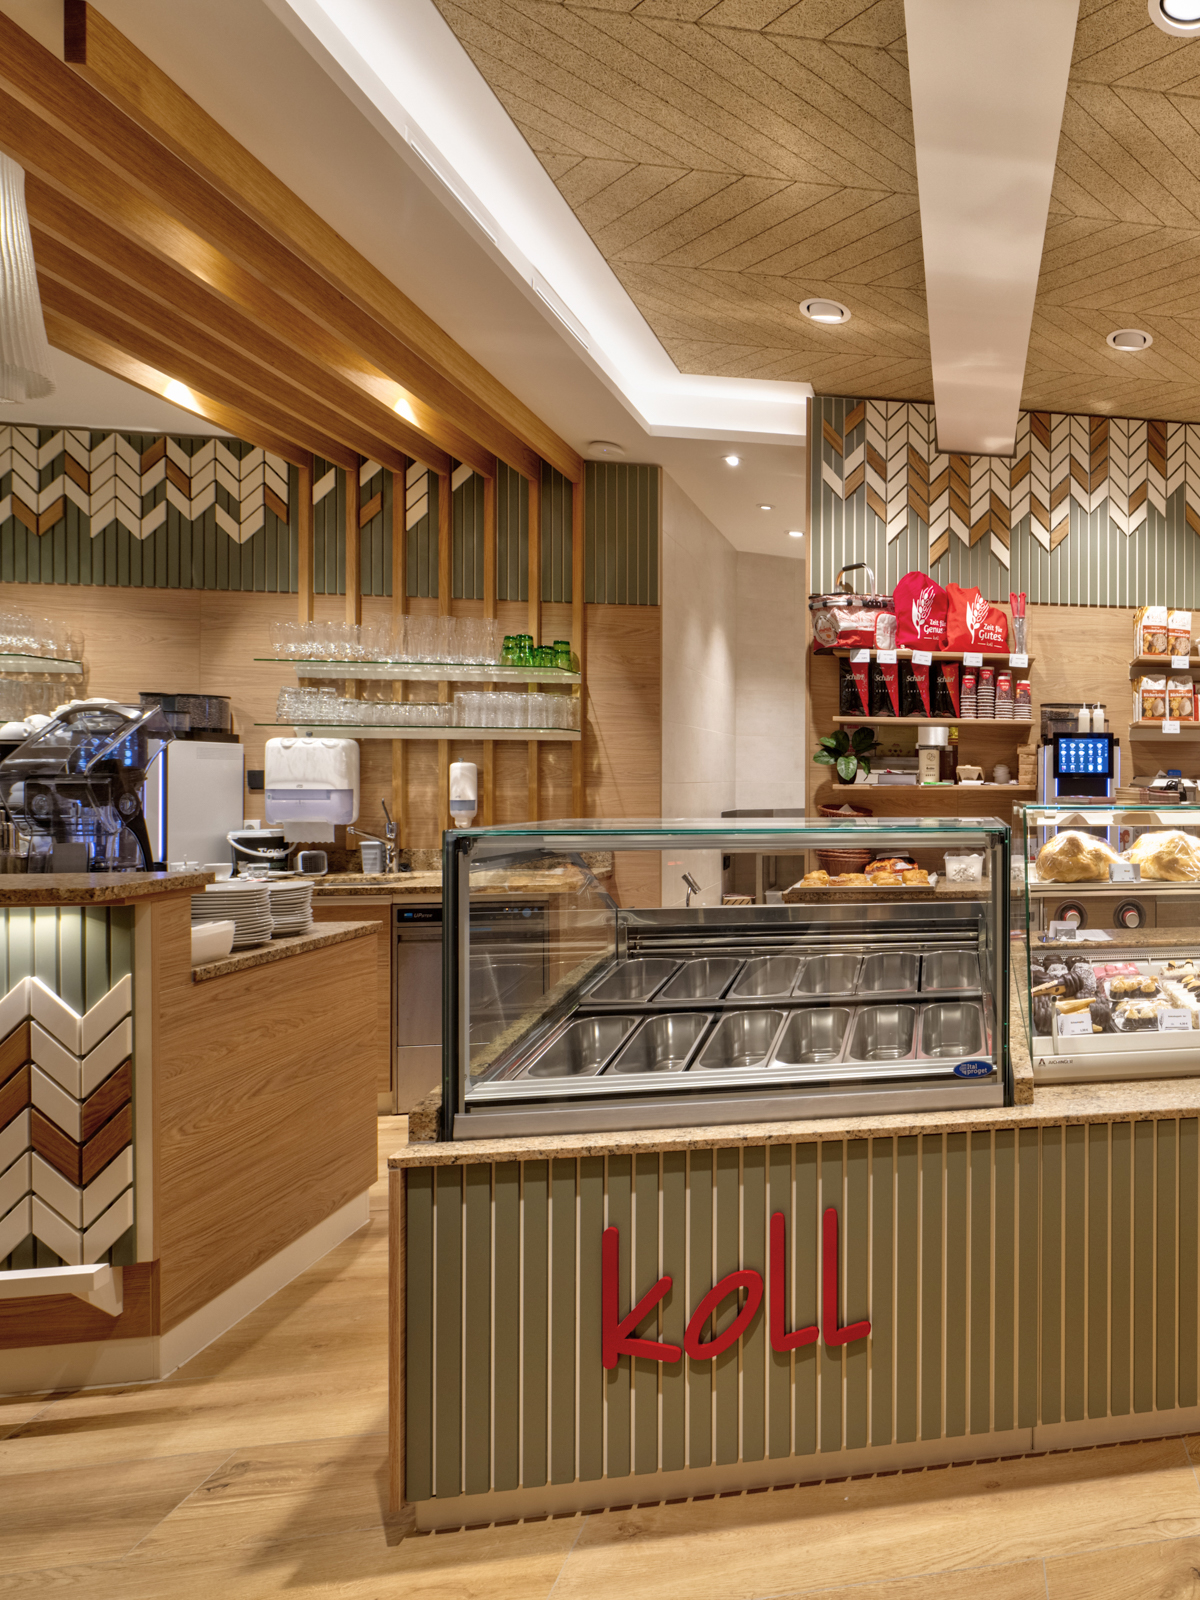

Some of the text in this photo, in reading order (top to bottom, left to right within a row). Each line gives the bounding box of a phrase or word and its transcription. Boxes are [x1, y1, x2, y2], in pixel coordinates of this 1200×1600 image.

[923, 625, 945, 634] Genus
[983, 623, 1003, 633] Zeit für
[978, 629, 1004, 642] Gutes.
[602, 1208, 871, 1370] koll
